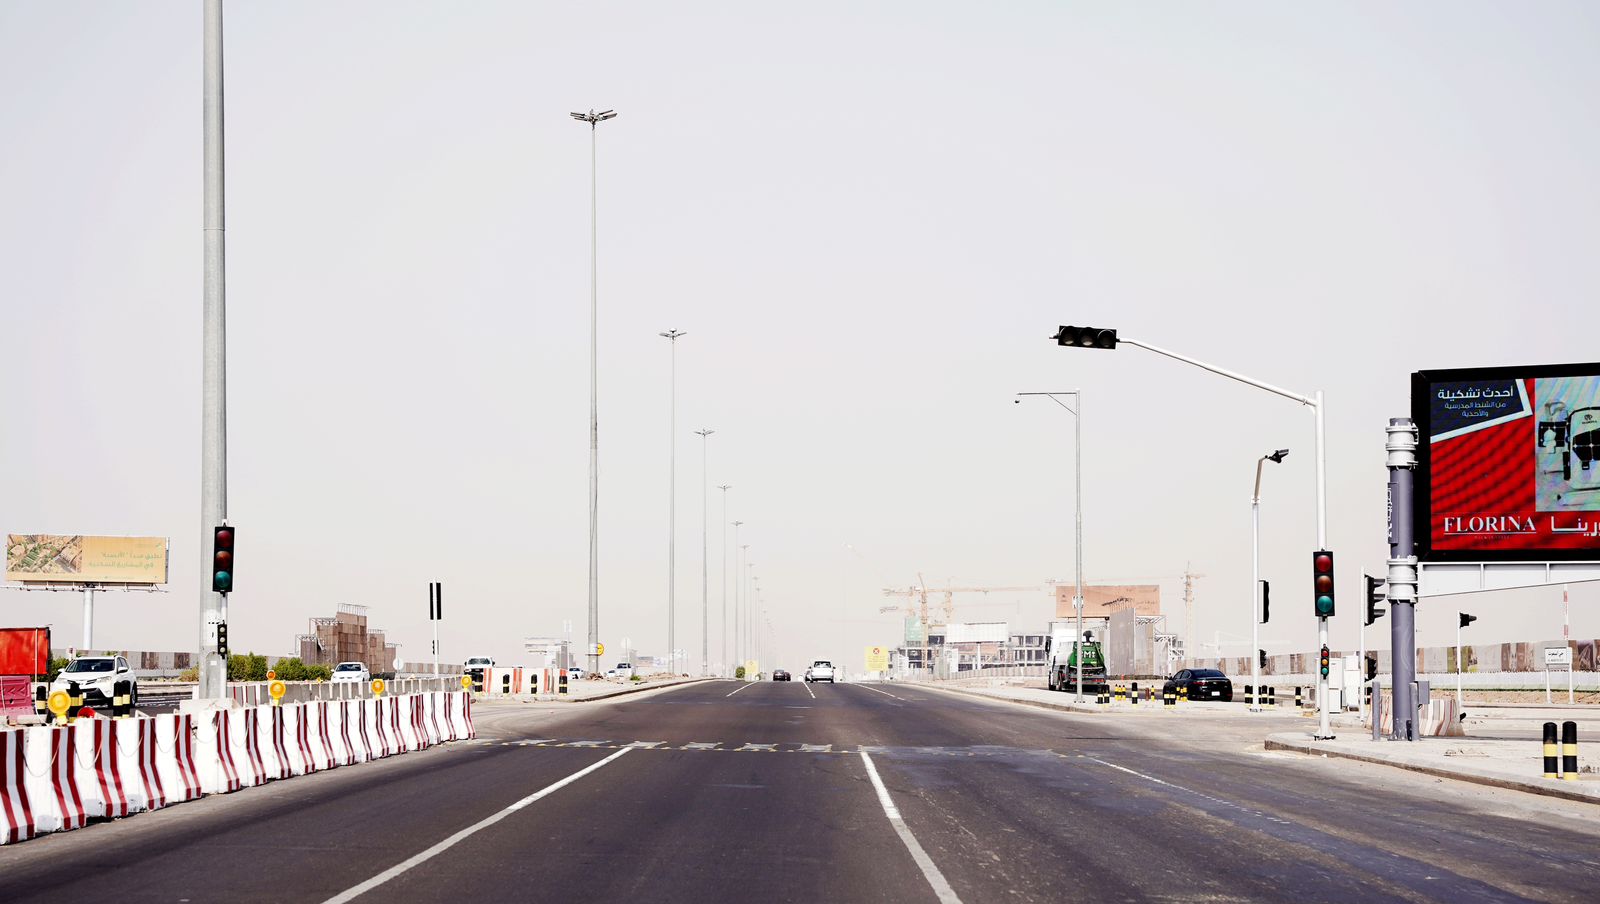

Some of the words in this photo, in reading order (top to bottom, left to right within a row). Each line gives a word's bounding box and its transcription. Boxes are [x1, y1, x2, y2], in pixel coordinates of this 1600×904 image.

[1437, 387, 1480, 402] تشكيلة
[1482, 385, 1514, 398] أحدث
[1444, 515, 1537, 532] FLORINA
